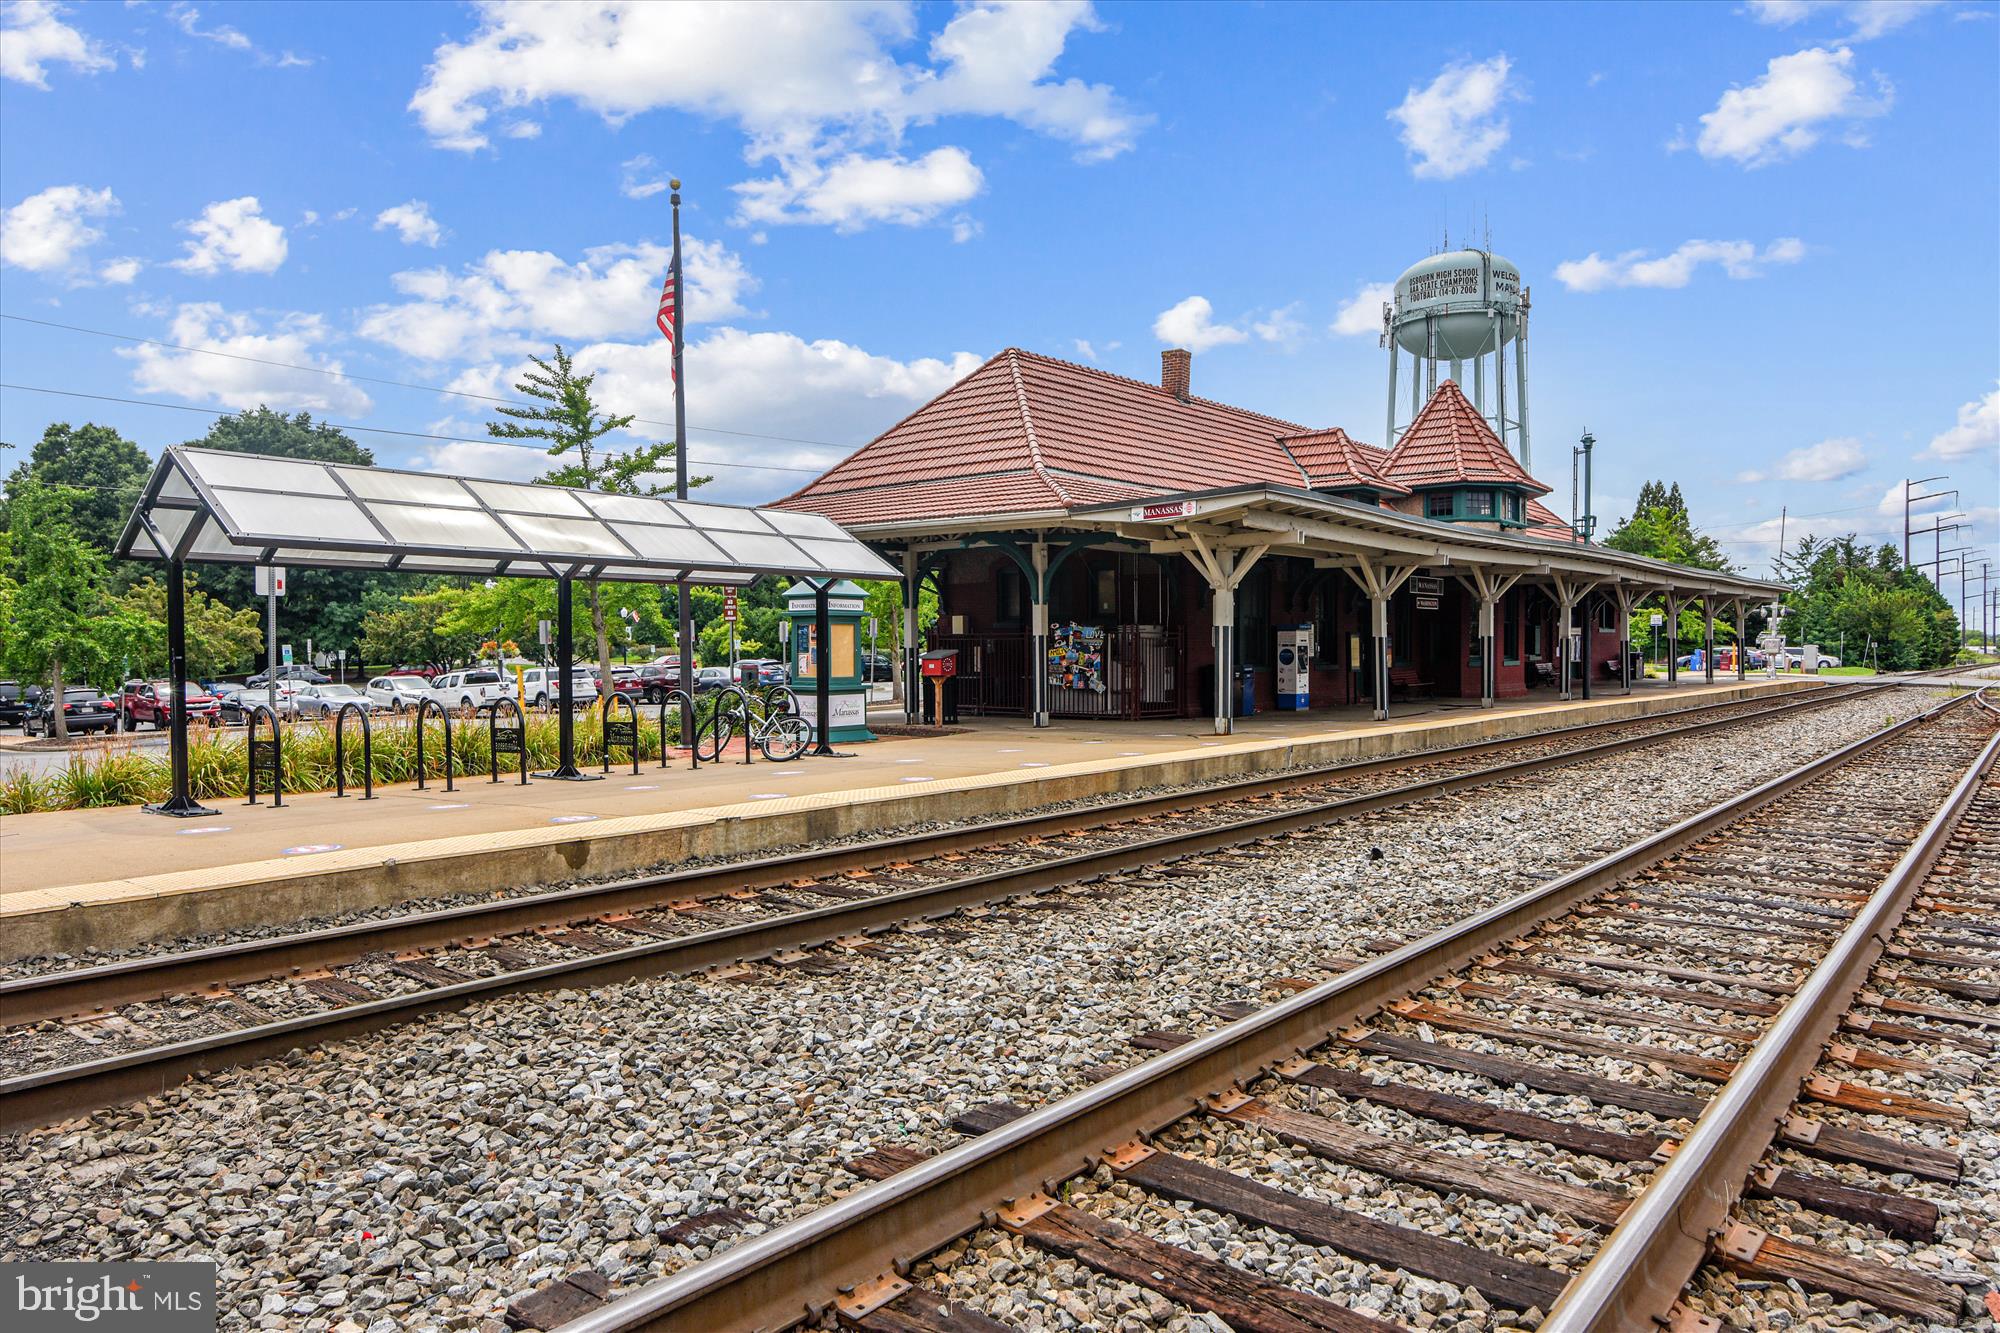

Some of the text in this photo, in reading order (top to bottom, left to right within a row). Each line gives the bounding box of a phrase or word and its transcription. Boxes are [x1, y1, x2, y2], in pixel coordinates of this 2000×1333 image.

[1410, 268, 1478, 286] OSBOURN HIGH SCHOOL
[1410, 276, 1478, 293] AAA STATE CHAMPIONS
[1410, 286, 1477, 303] FOOTBALL (14-0) 2006
[1144, 505, 1183, 516] MANASSAS
[832, 708, 860, 717] Manassas
